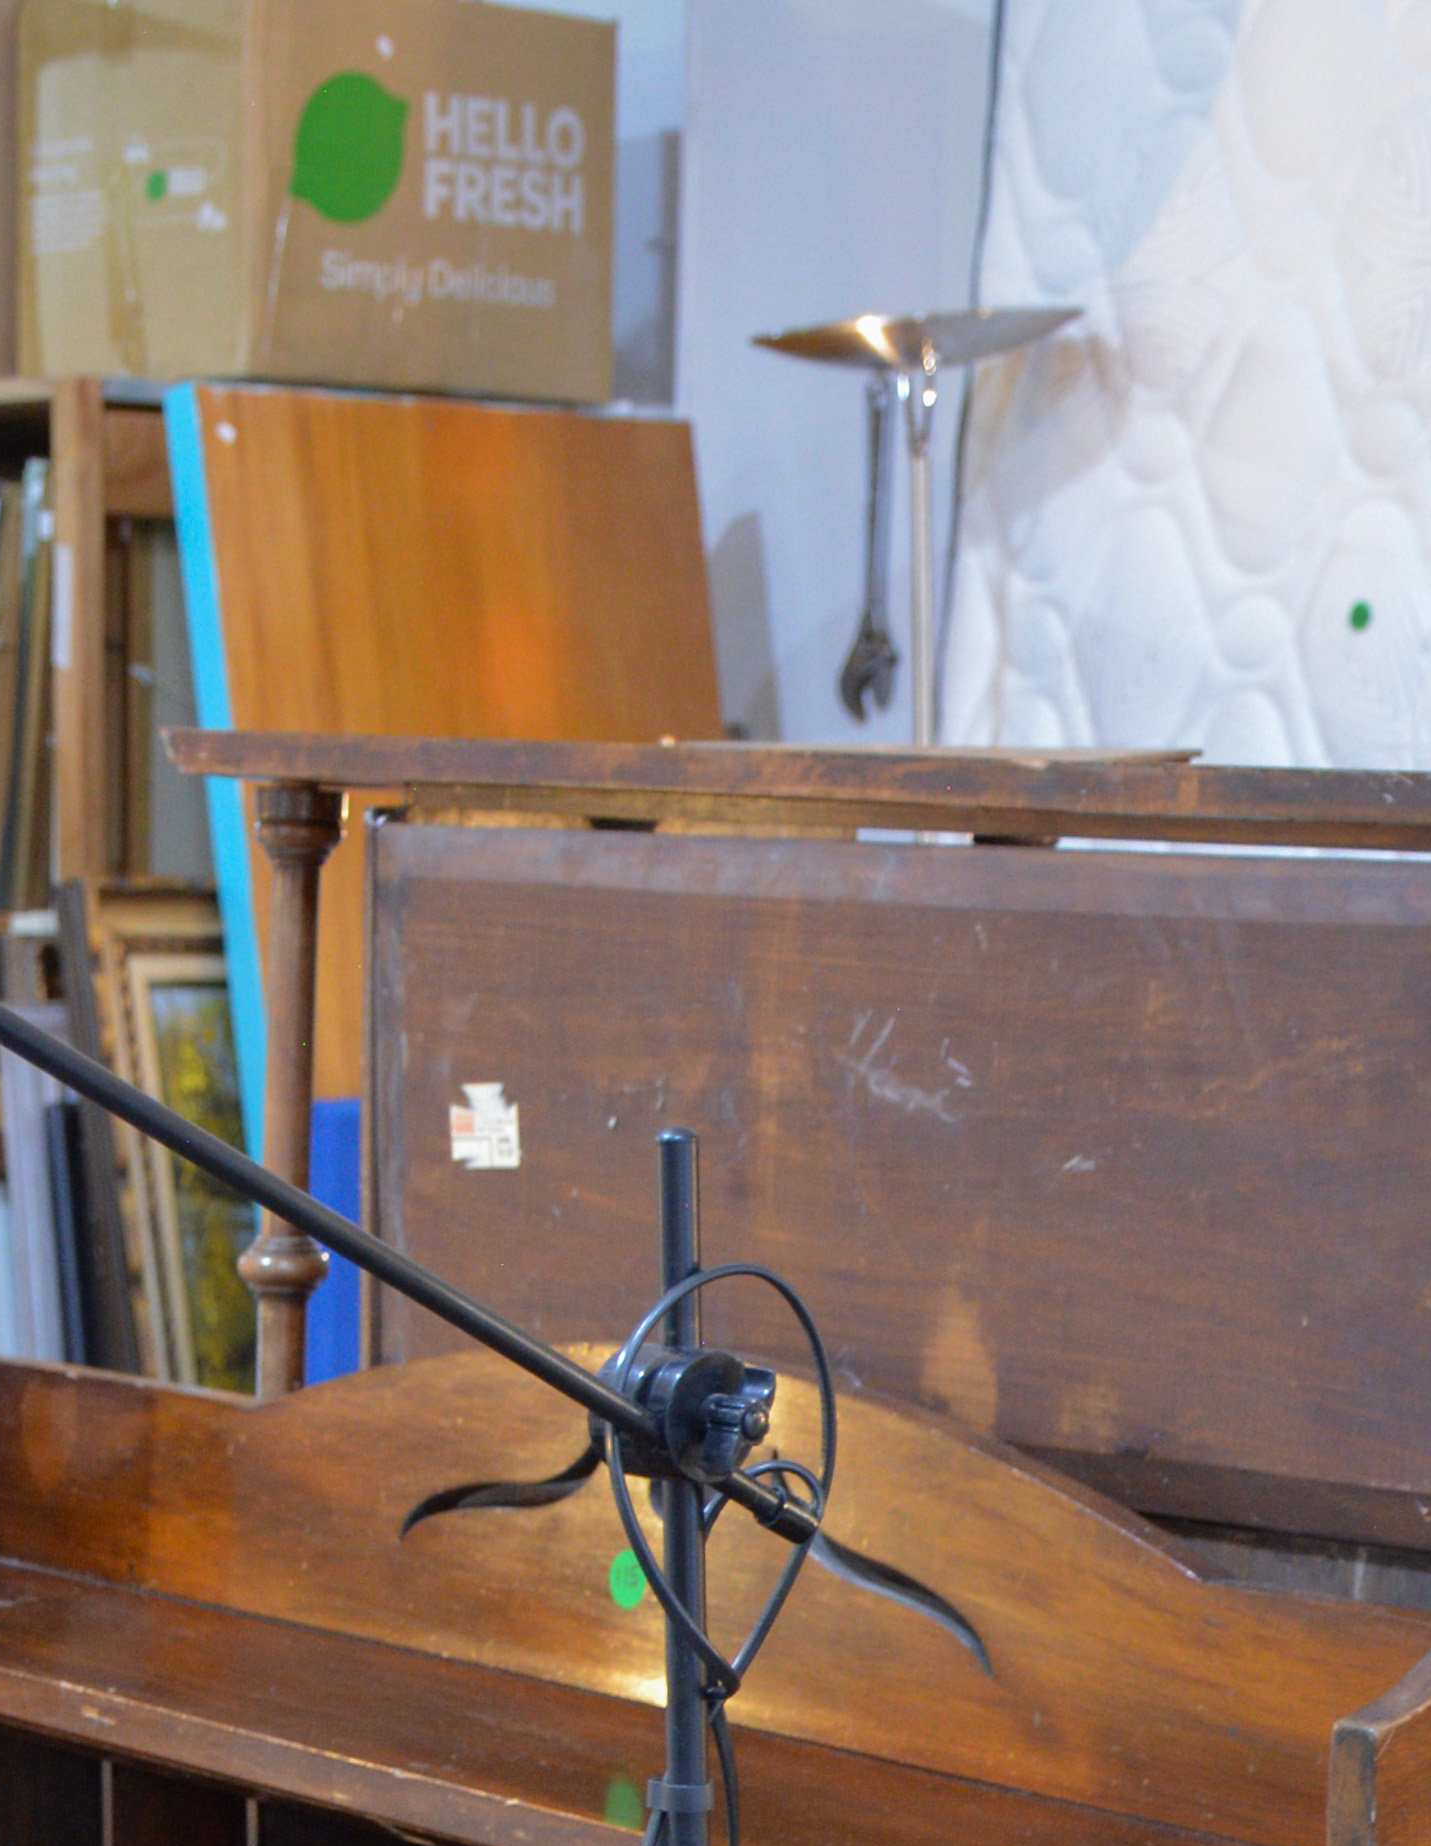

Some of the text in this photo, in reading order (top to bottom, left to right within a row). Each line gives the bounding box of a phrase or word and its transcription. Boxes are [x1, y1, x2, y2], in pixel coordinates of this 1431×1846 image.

[424, 90, 585, 170] HELLO
[424, 157, 585, 235] FRESH
[320, 250, 557, 309] Simply Delicious
